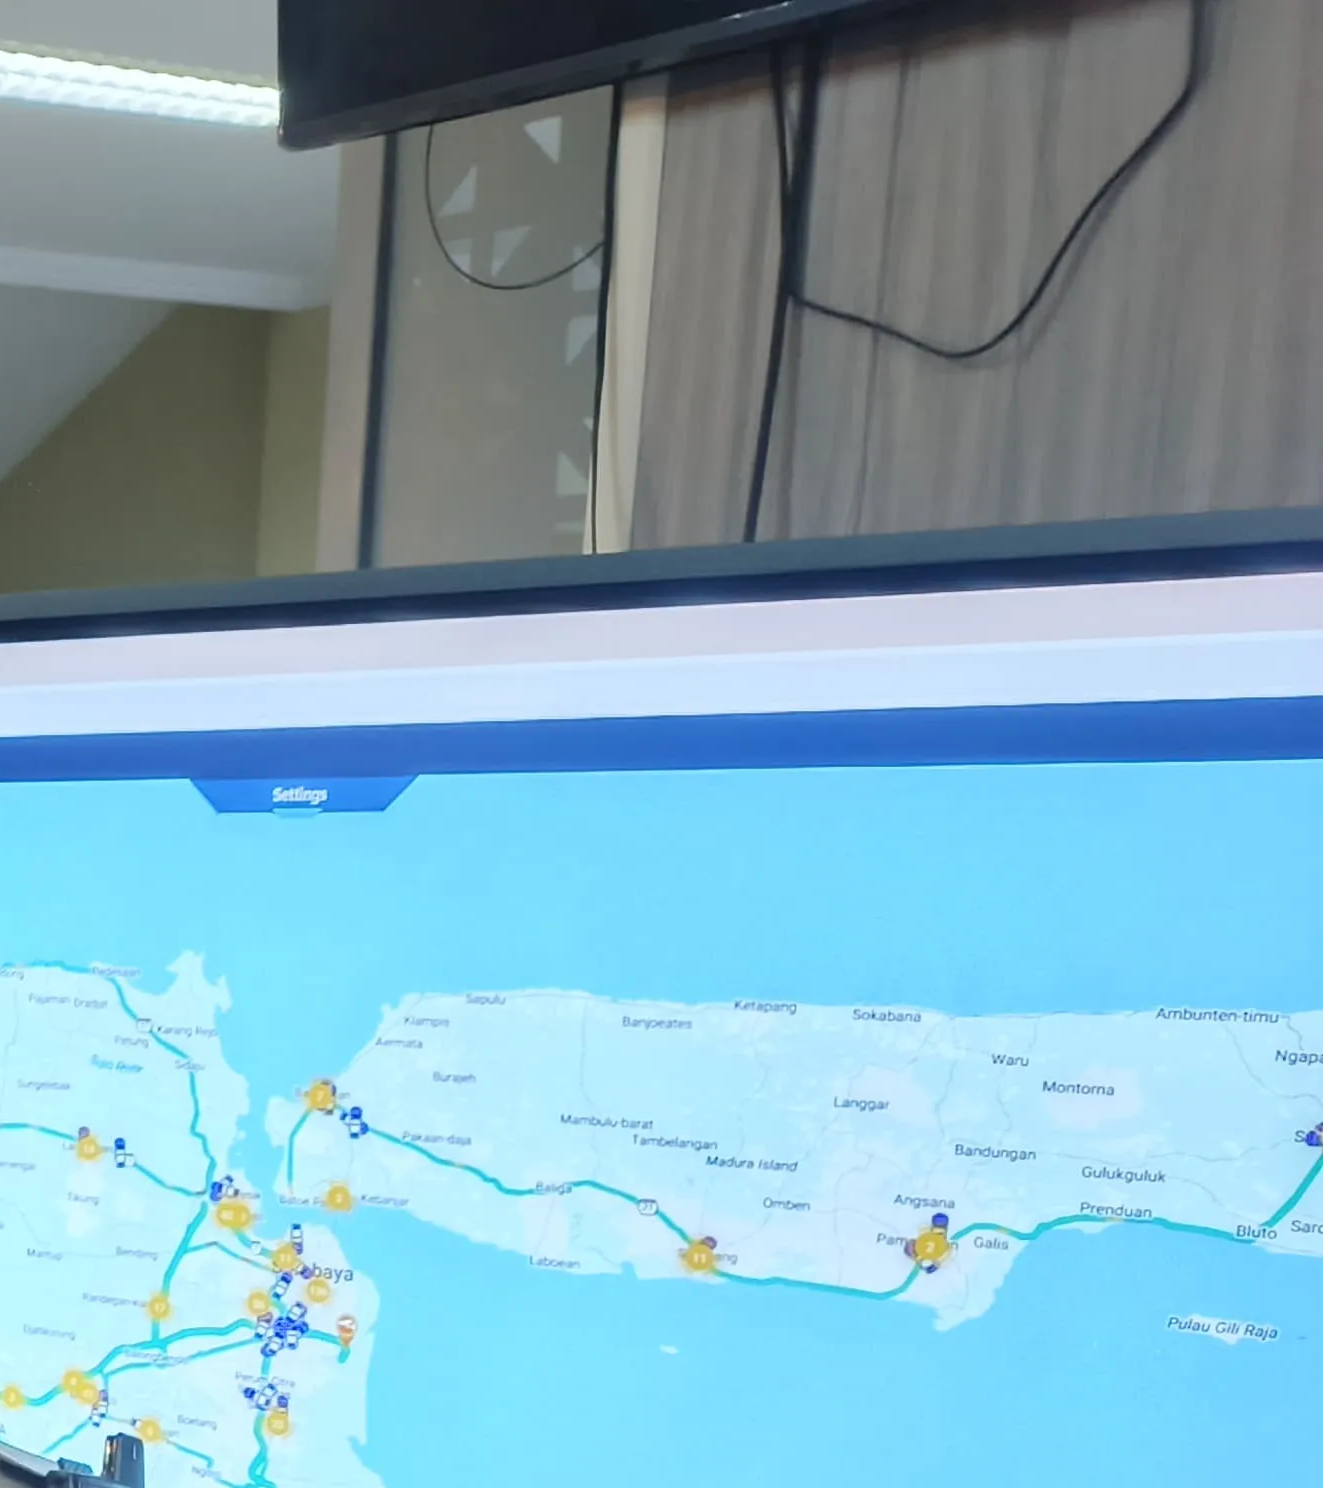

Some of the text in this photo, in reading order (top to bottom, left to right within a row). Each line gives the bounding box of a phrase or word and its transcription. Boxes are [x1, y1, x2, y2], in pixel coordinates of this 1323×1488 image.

[271, 785, 329, 806] Settings
[734, 999, 798, 1016] Ketapang
[991, 1053, 1030, 1067] Waru
[1042, 1080, 1116, 1097] Montorna
[833, 1096, 891, 1113] Langgar
[631, 1133, 718, 1152] Tambelangan
[954, 1143, 1038, 1163] Bandungan
[705, 1154, 798, 1173] Madura Island
[1081, 1165, 1167, 1184] Gulukguluk
[762, 1196, 812, 1212] Omben
[892, 1193, 956, 1210] Angsana
[1079, 1201, 1153, 1219] Prenduan
[1235, 1224, 1278, 1241] Bluto
[972, 1235, 1010, 1251] Galis
[1166, 1315, 1279, 1341] Pulau Gili Raja
